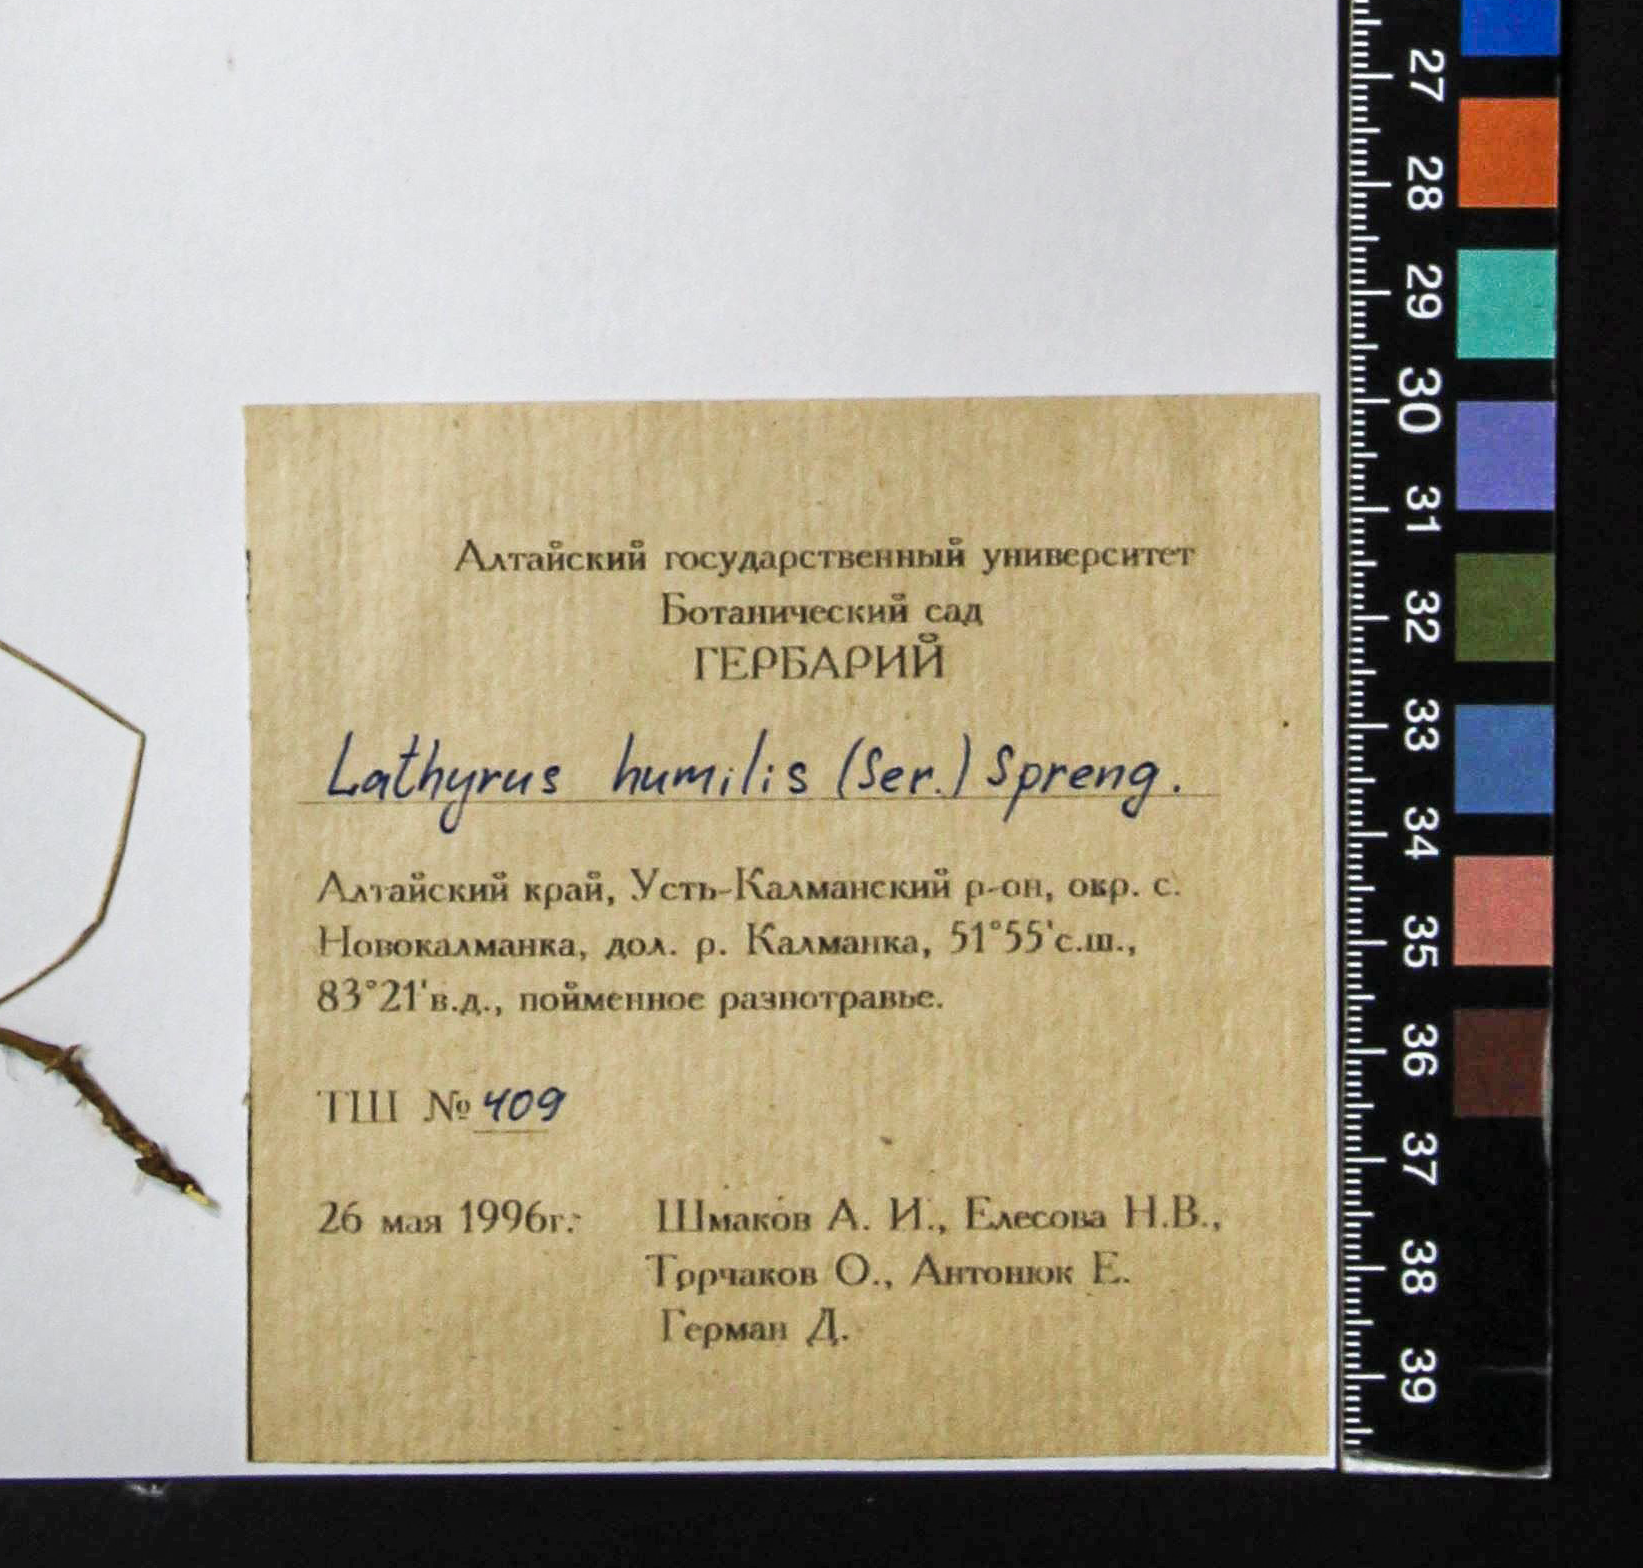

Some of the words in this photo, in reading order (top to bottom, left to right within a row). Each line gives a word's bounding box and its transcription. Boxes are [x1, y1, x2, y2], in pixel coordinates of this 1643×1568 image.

[1409, 48, 1445, 102] 27
[1406, 155, 1444, 211] 28
[1406, 264, 1443, 319] 29
[1398, 366, 1442, 434] 30
[1406, 485, 1442, 532] 31
[454, 538, 647, 573] Алтайский
[664, 536, 966, 578] государственный
[982, 546, 1196, 576] университет
[660, 591, 909, 626] Ботанический
[924, 603, 983, 627] сад
[1405, 590, 1441, 644] 32
[693, 631, 946, 681] ГЕРБАРИЙ
[1404, 698, 1440, 752] 33
[326, 730, 562, 835] Lathyrus
[612, 728, 810, 797] humilis
[985, 742, 1184, 823] Spreng.
[1403, 806, 1440, 860] 34
[316, 870, 510, 905] Алтайский
[523, 870, 617, 911] край,
[630, 866, 952, 904] Усть-Калманский
[964, 878, 1056, 907] р-он,
[1067, 878, 1141, 902] окр.
[317, 925, 591, 964] Новокалманка,
[604, 937, 679, 962] дол.
[694, 937, 728, 965] р.
[746, 921, 933, 961] Калманка,
[1403, 915, 1439, 968] 35
[518, 980, 706, 1014] пойменное
[718, 988, 945, 1020] разнотравье.
[1402, 1023, 1439, 1077] 36
[481, 1085, 568, 1123] 409
[1402, 1131, 1438, 1186] 37
[317, 1200, 364, 1235] 26
[379, 1212, 443, 1235] мая
[656, 1197, 813, 1234] Шмаков
[827, 1196, 870, 1232] А.
[965, 1195, 1108, 1232] Елесова
[910, 1251, 1075, 1287] Антонюк
[1092, 1249, 1132, 1285] Е.
[1400, 1239, 1438, 1295] 38
[660, 1307, 789, 1350] Герман
[805, 1306, 850, 1348] Д.
[1400, 1348, 1437, 1403] 39
